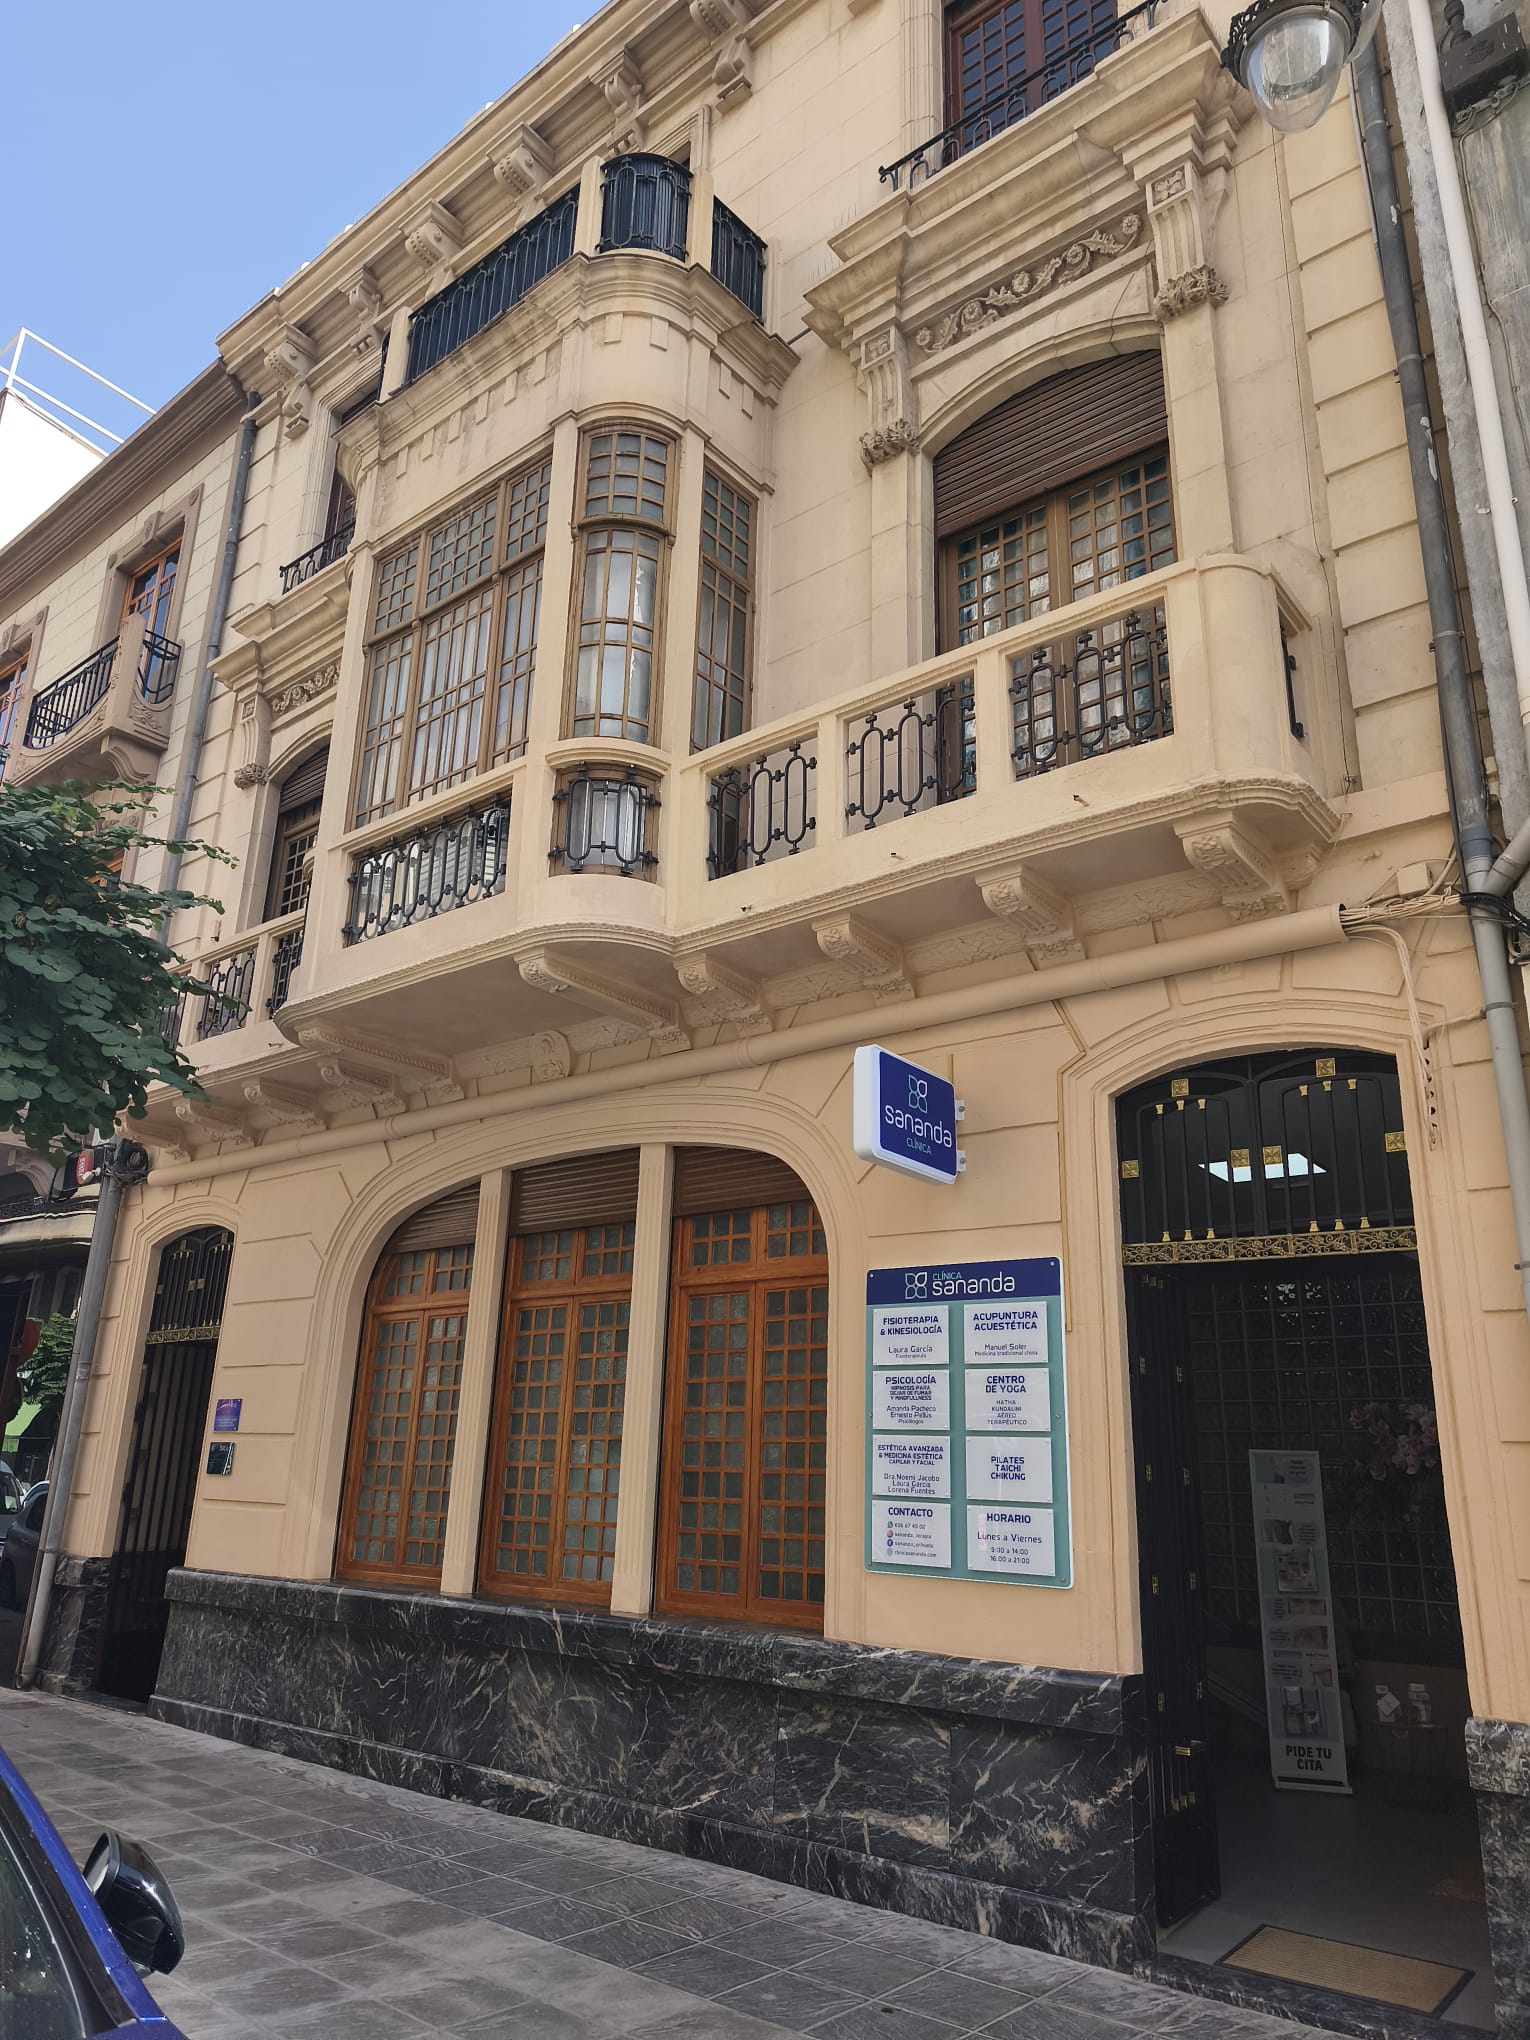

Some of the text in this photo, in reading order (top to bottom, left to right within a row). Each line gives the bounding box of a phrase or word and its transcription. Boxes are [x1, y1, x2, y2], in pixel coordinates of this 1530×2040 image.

[885, 1105, 952, 1147] sananda
[907, 1138, 931, 1154] CLÍNICA
[933, 1271, 961, 1280] CLÍNICA
[932, 1272, 1015, 1296] sananda
[883, 1316, 938, 1325] FISIOTERAPIA
[973, 1311, 1038, 1320] ACUPUNTURA
[888, 1325, 942, 1335] KINESIOLOGÍA
[975, 1320, 1037, 1330] ACUESTÉTICA
[886, 1374, 936, 1384] PSICOLOGÍA
[991, 1456, 1024, 1464] PILATES
[888, 1507, 933, 1517] CONTACTO
[987, 1513, 1031, 1523] HORARIO
[978, 1532, 1000, 1540] Lunes
[1011, 1534, 1042, 1543] Viernes
[1286, 1745, 1331, 1759] PIDE TU
[1297, 1759, 1323, 1771] CITA
